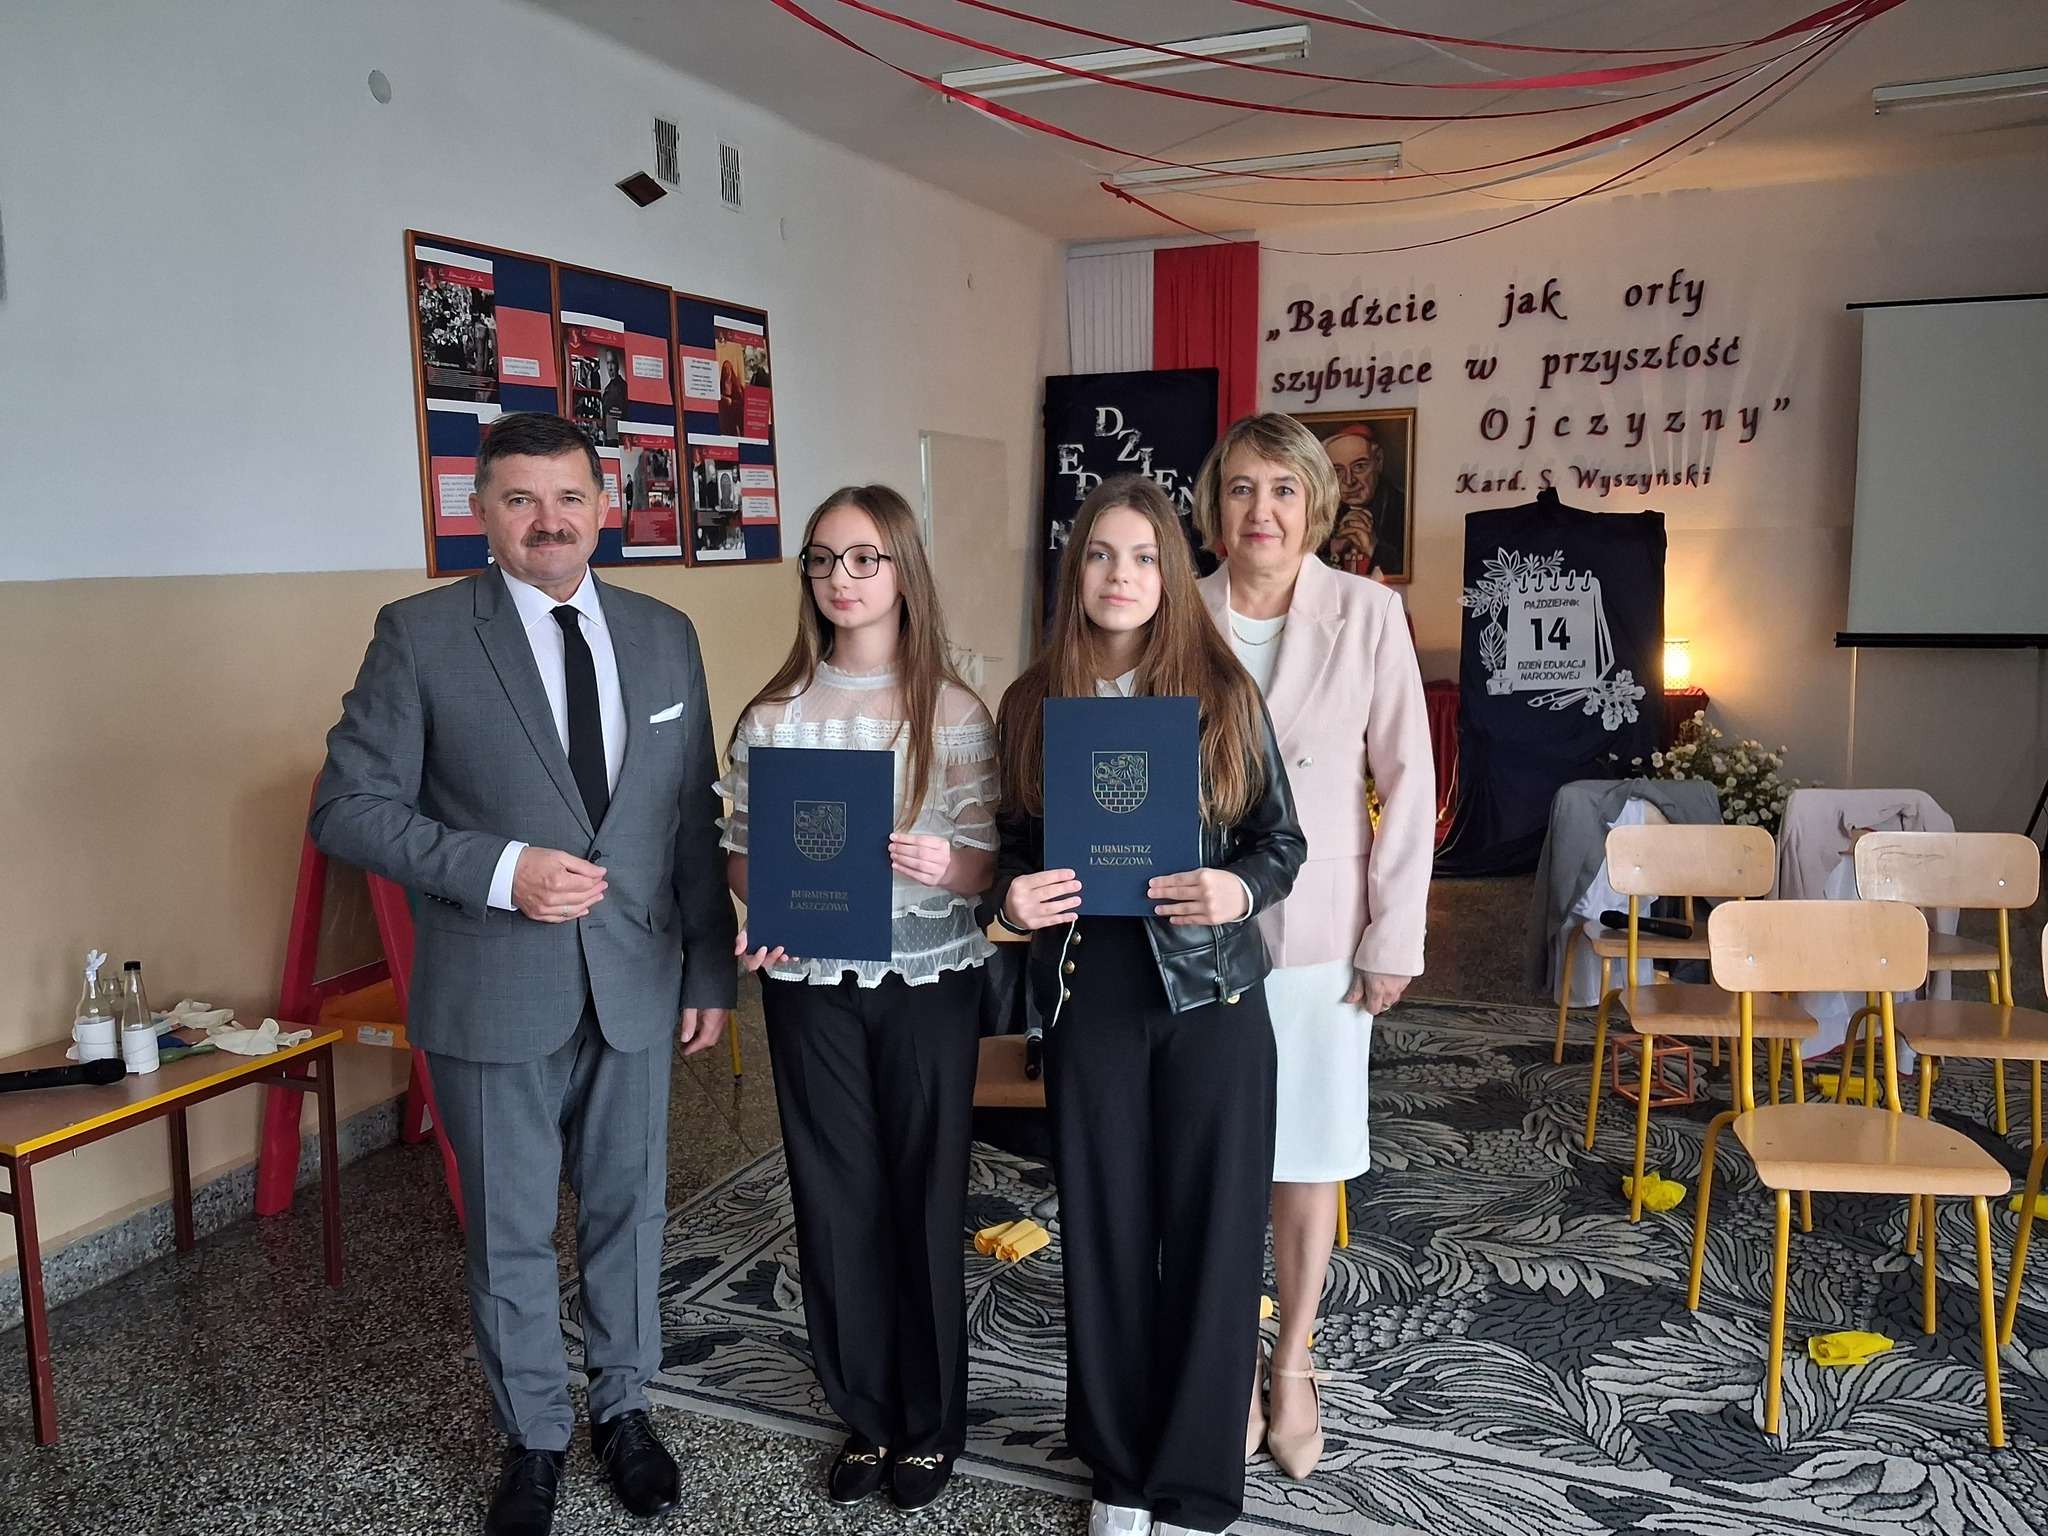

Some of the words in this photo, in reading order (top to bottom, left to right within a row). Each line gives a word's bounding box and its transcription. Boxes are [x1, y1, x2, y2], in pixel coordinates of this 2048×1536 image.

[1498, 278, 1569, 328] jak
[1624, 268, 1705, 317] orły
[1271, 356, 1433, 404] szybujące
[1465, 355, 1498, 380] w
[1539, 334, 1741, 389] przyszłość
[1455, 470, 1526, 493] Kard.
[1568, 464, 1711, 497] Wyszyński
[1530, 616, 1571, 651] 14
[1517, 659, 1542, 670] DZIEŃ
[1543, 659, 1586, 669] EDUKACJI
[1520, 671, 1581, 681] NARODOWEJ
[1090, 844, 1152, 854] BURMISTRZ
